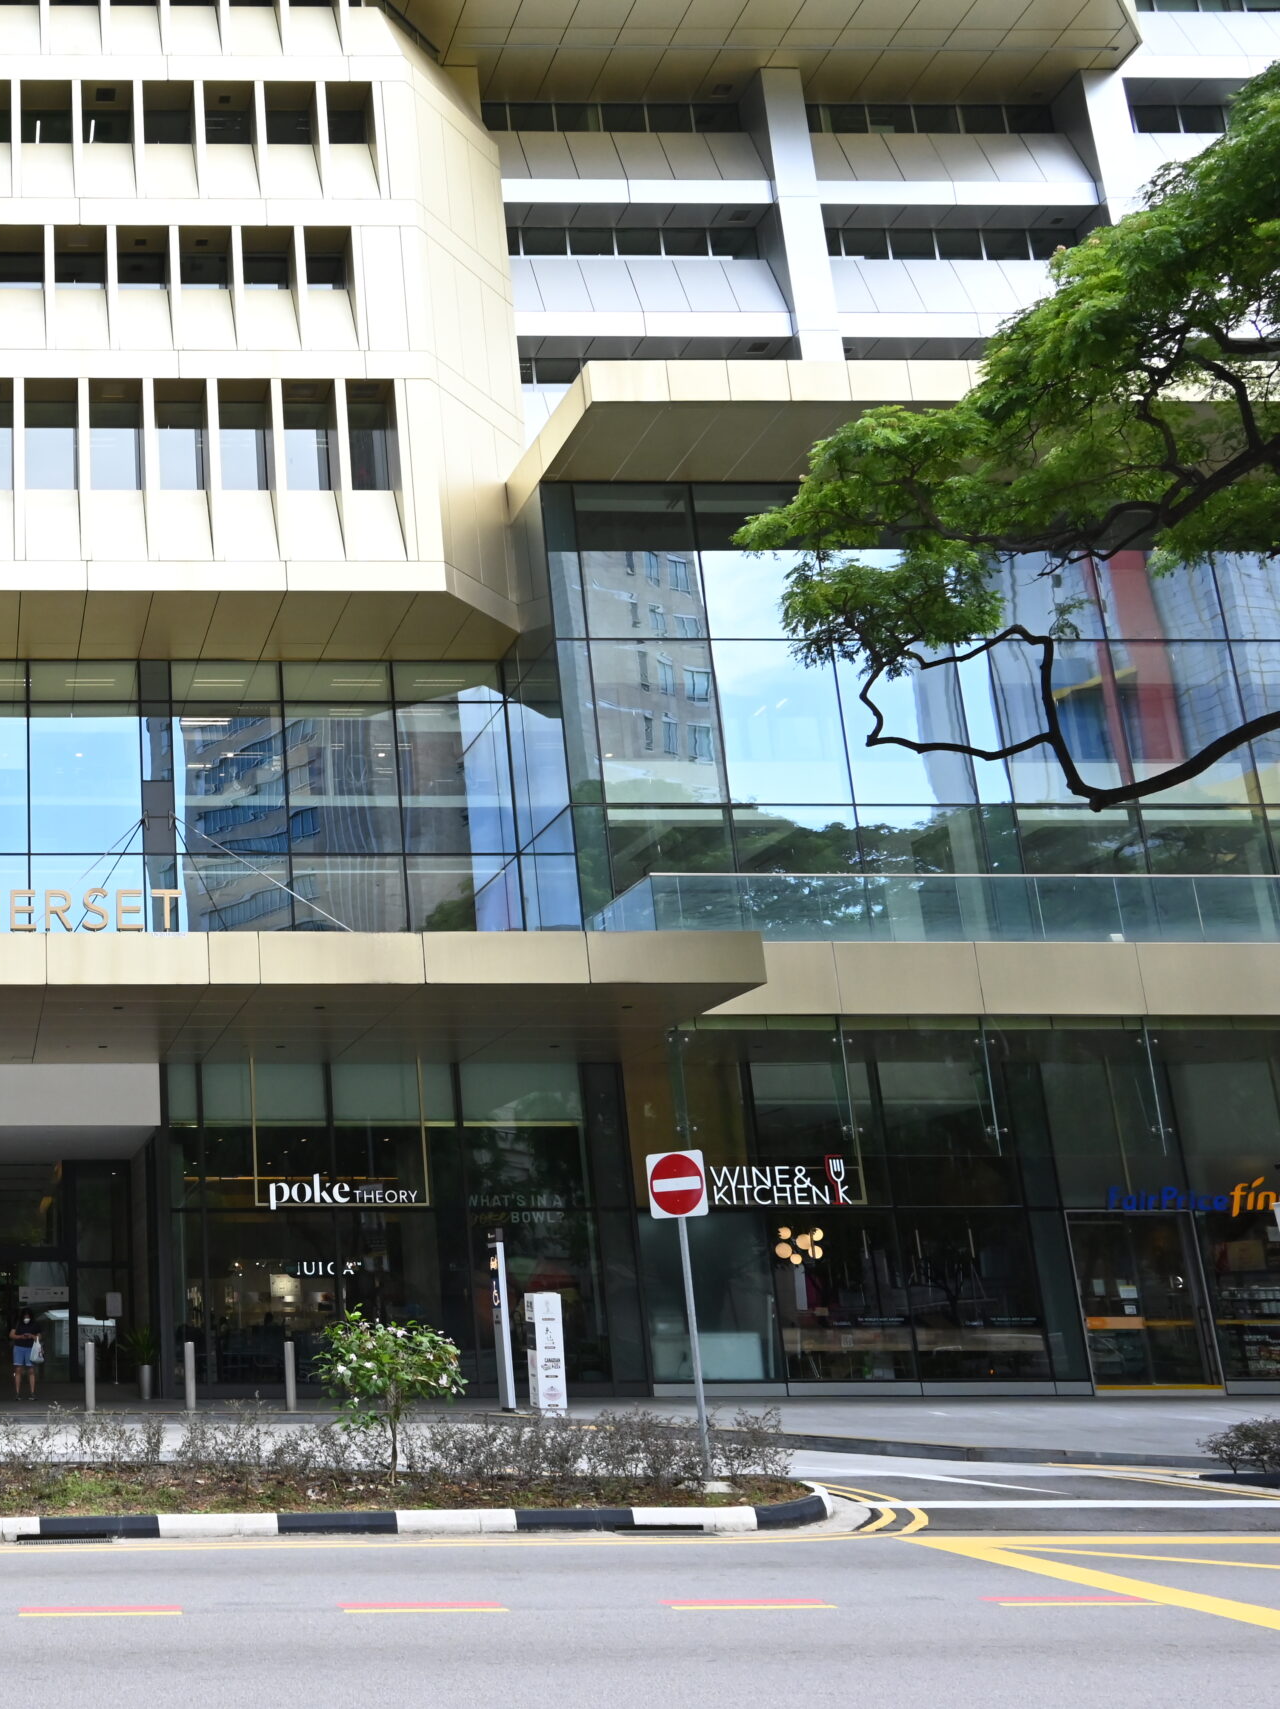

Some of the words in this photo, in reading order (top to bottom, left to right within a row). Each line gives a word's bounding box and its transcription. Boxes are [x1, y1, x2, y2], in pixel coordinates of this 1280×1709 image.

[269, 1173, 350, 1210] poke
[353, 1190, 418, 1203] THEORY
[713, 1184, 830, 1205] KITCHEN
[1108, 1186, 1228, 1211] FairPrice
[1230, 1176, 1280, 1217] fin
